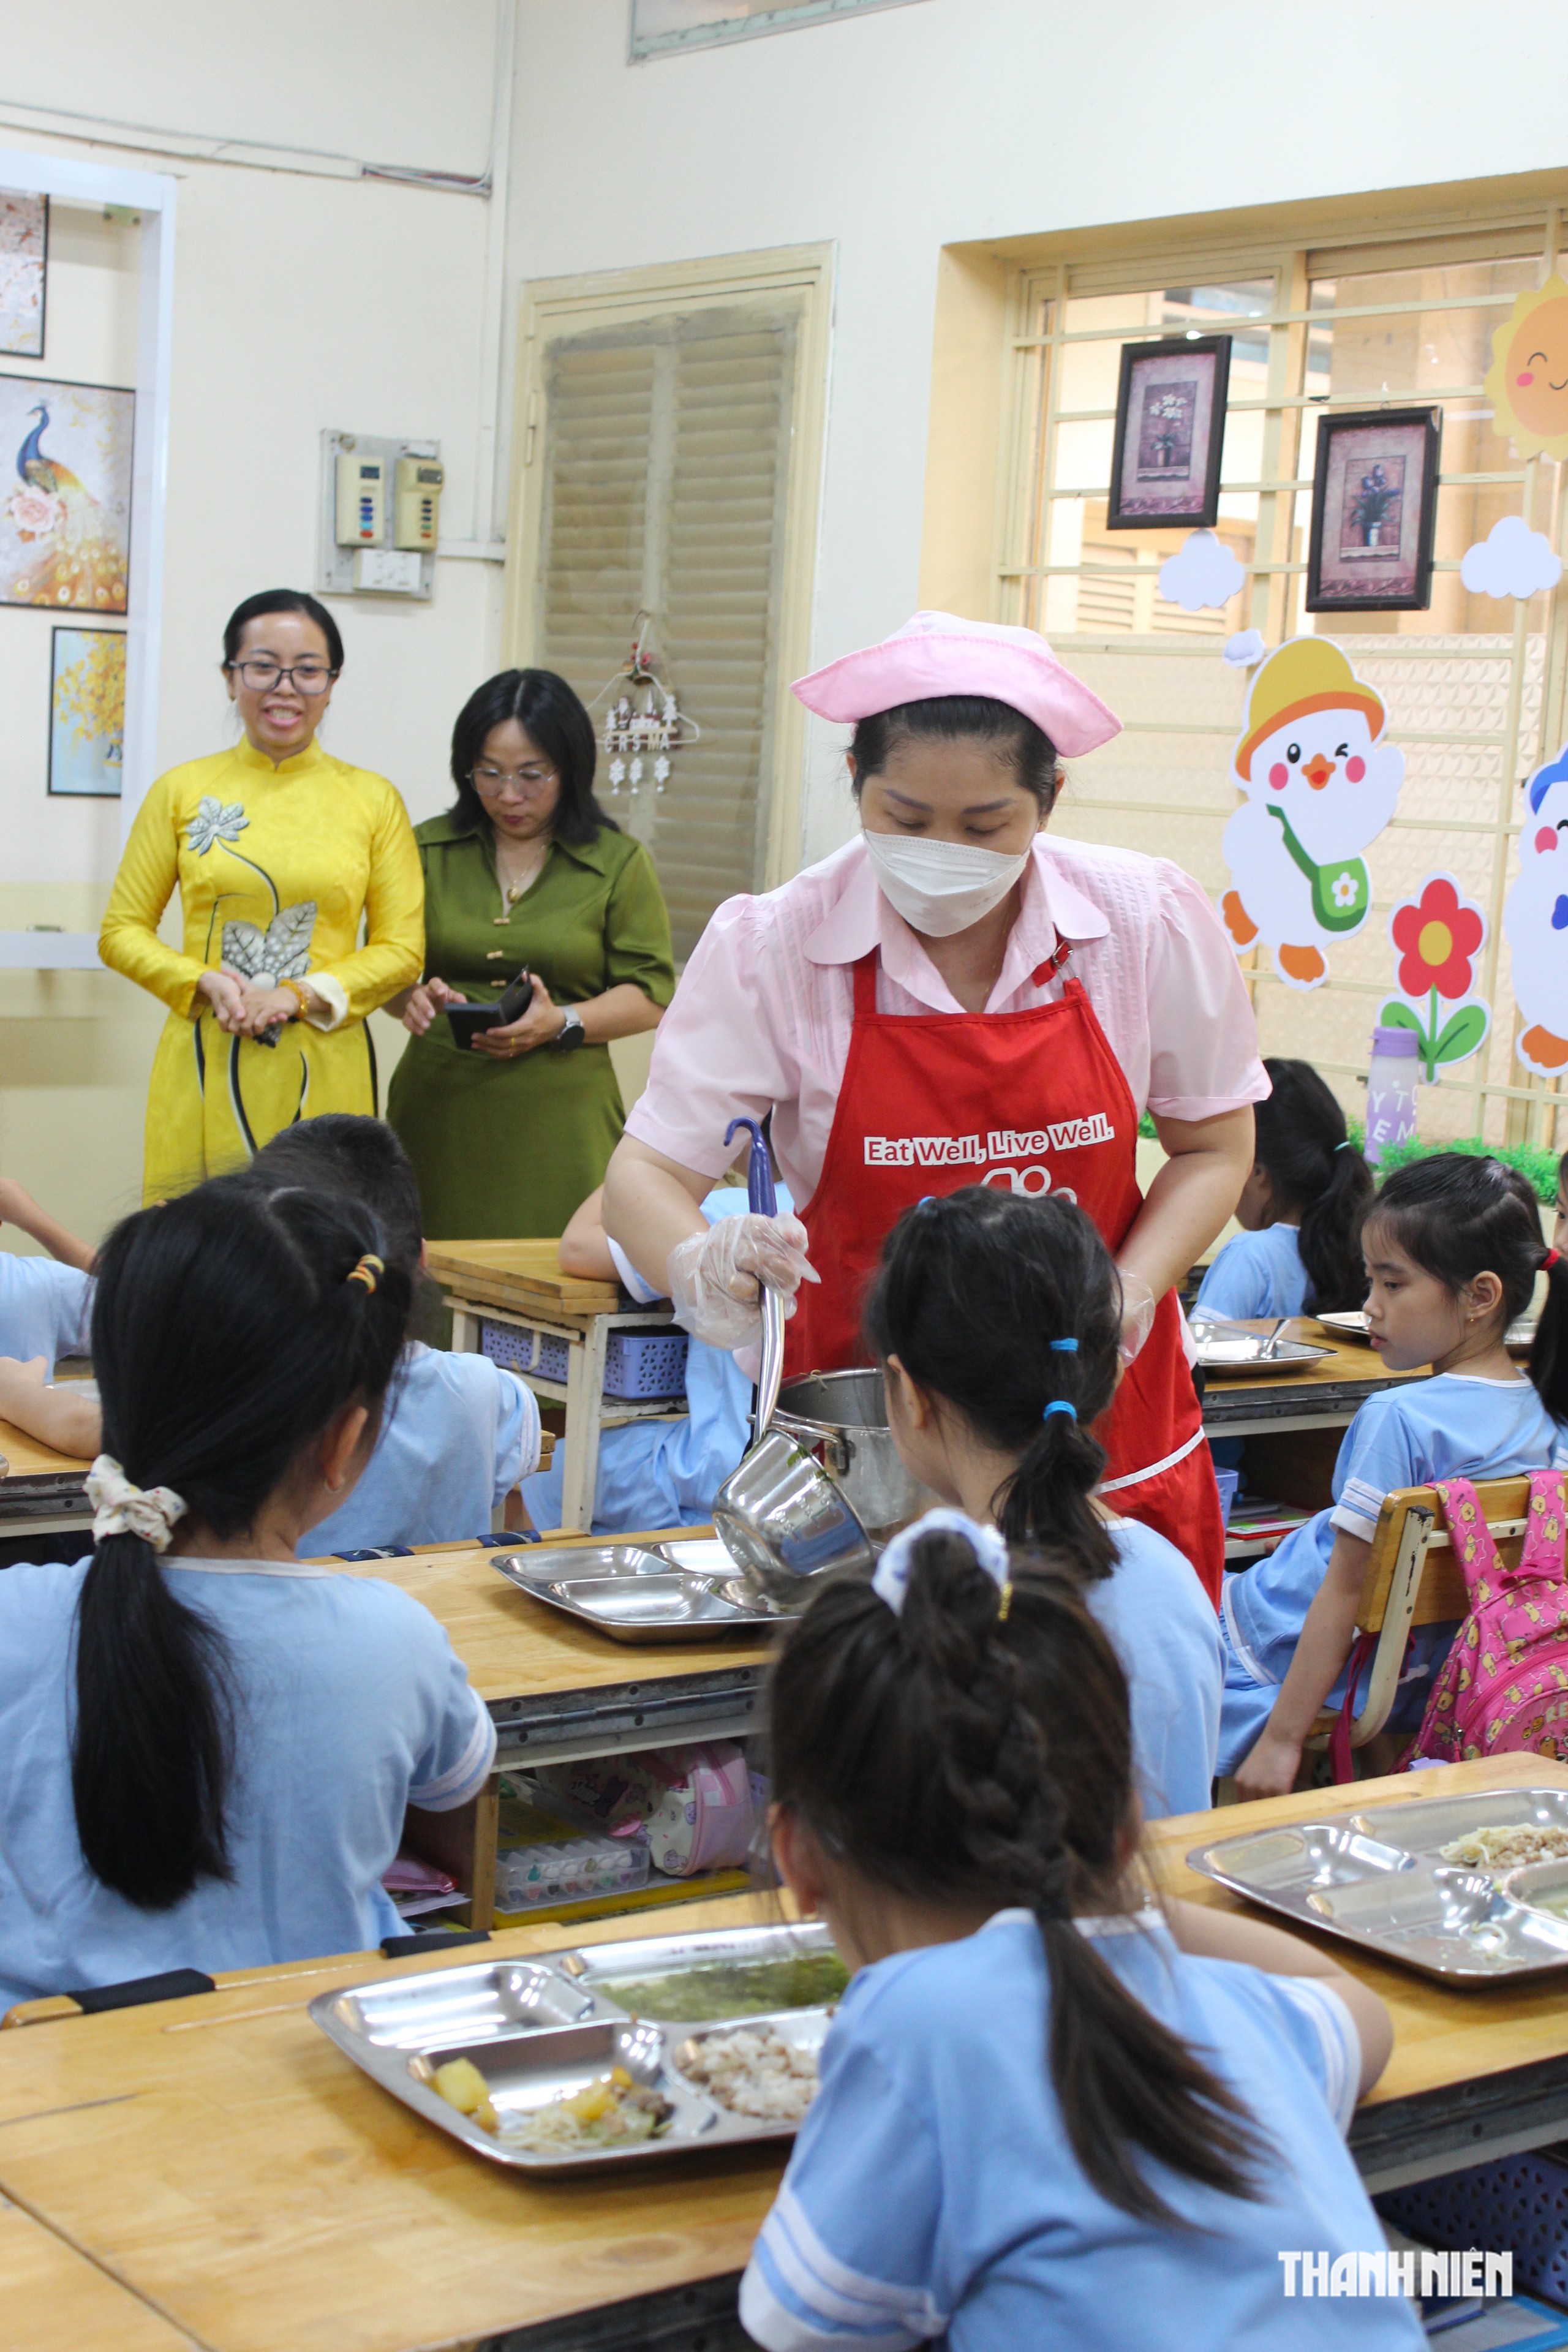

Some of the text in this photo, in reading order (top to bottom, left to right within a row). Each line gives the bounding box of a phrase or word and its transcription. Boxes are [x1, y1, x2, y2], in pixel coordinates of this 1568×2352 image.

[866, 1115, 1114, 1163] Eat Well, Live Well.
